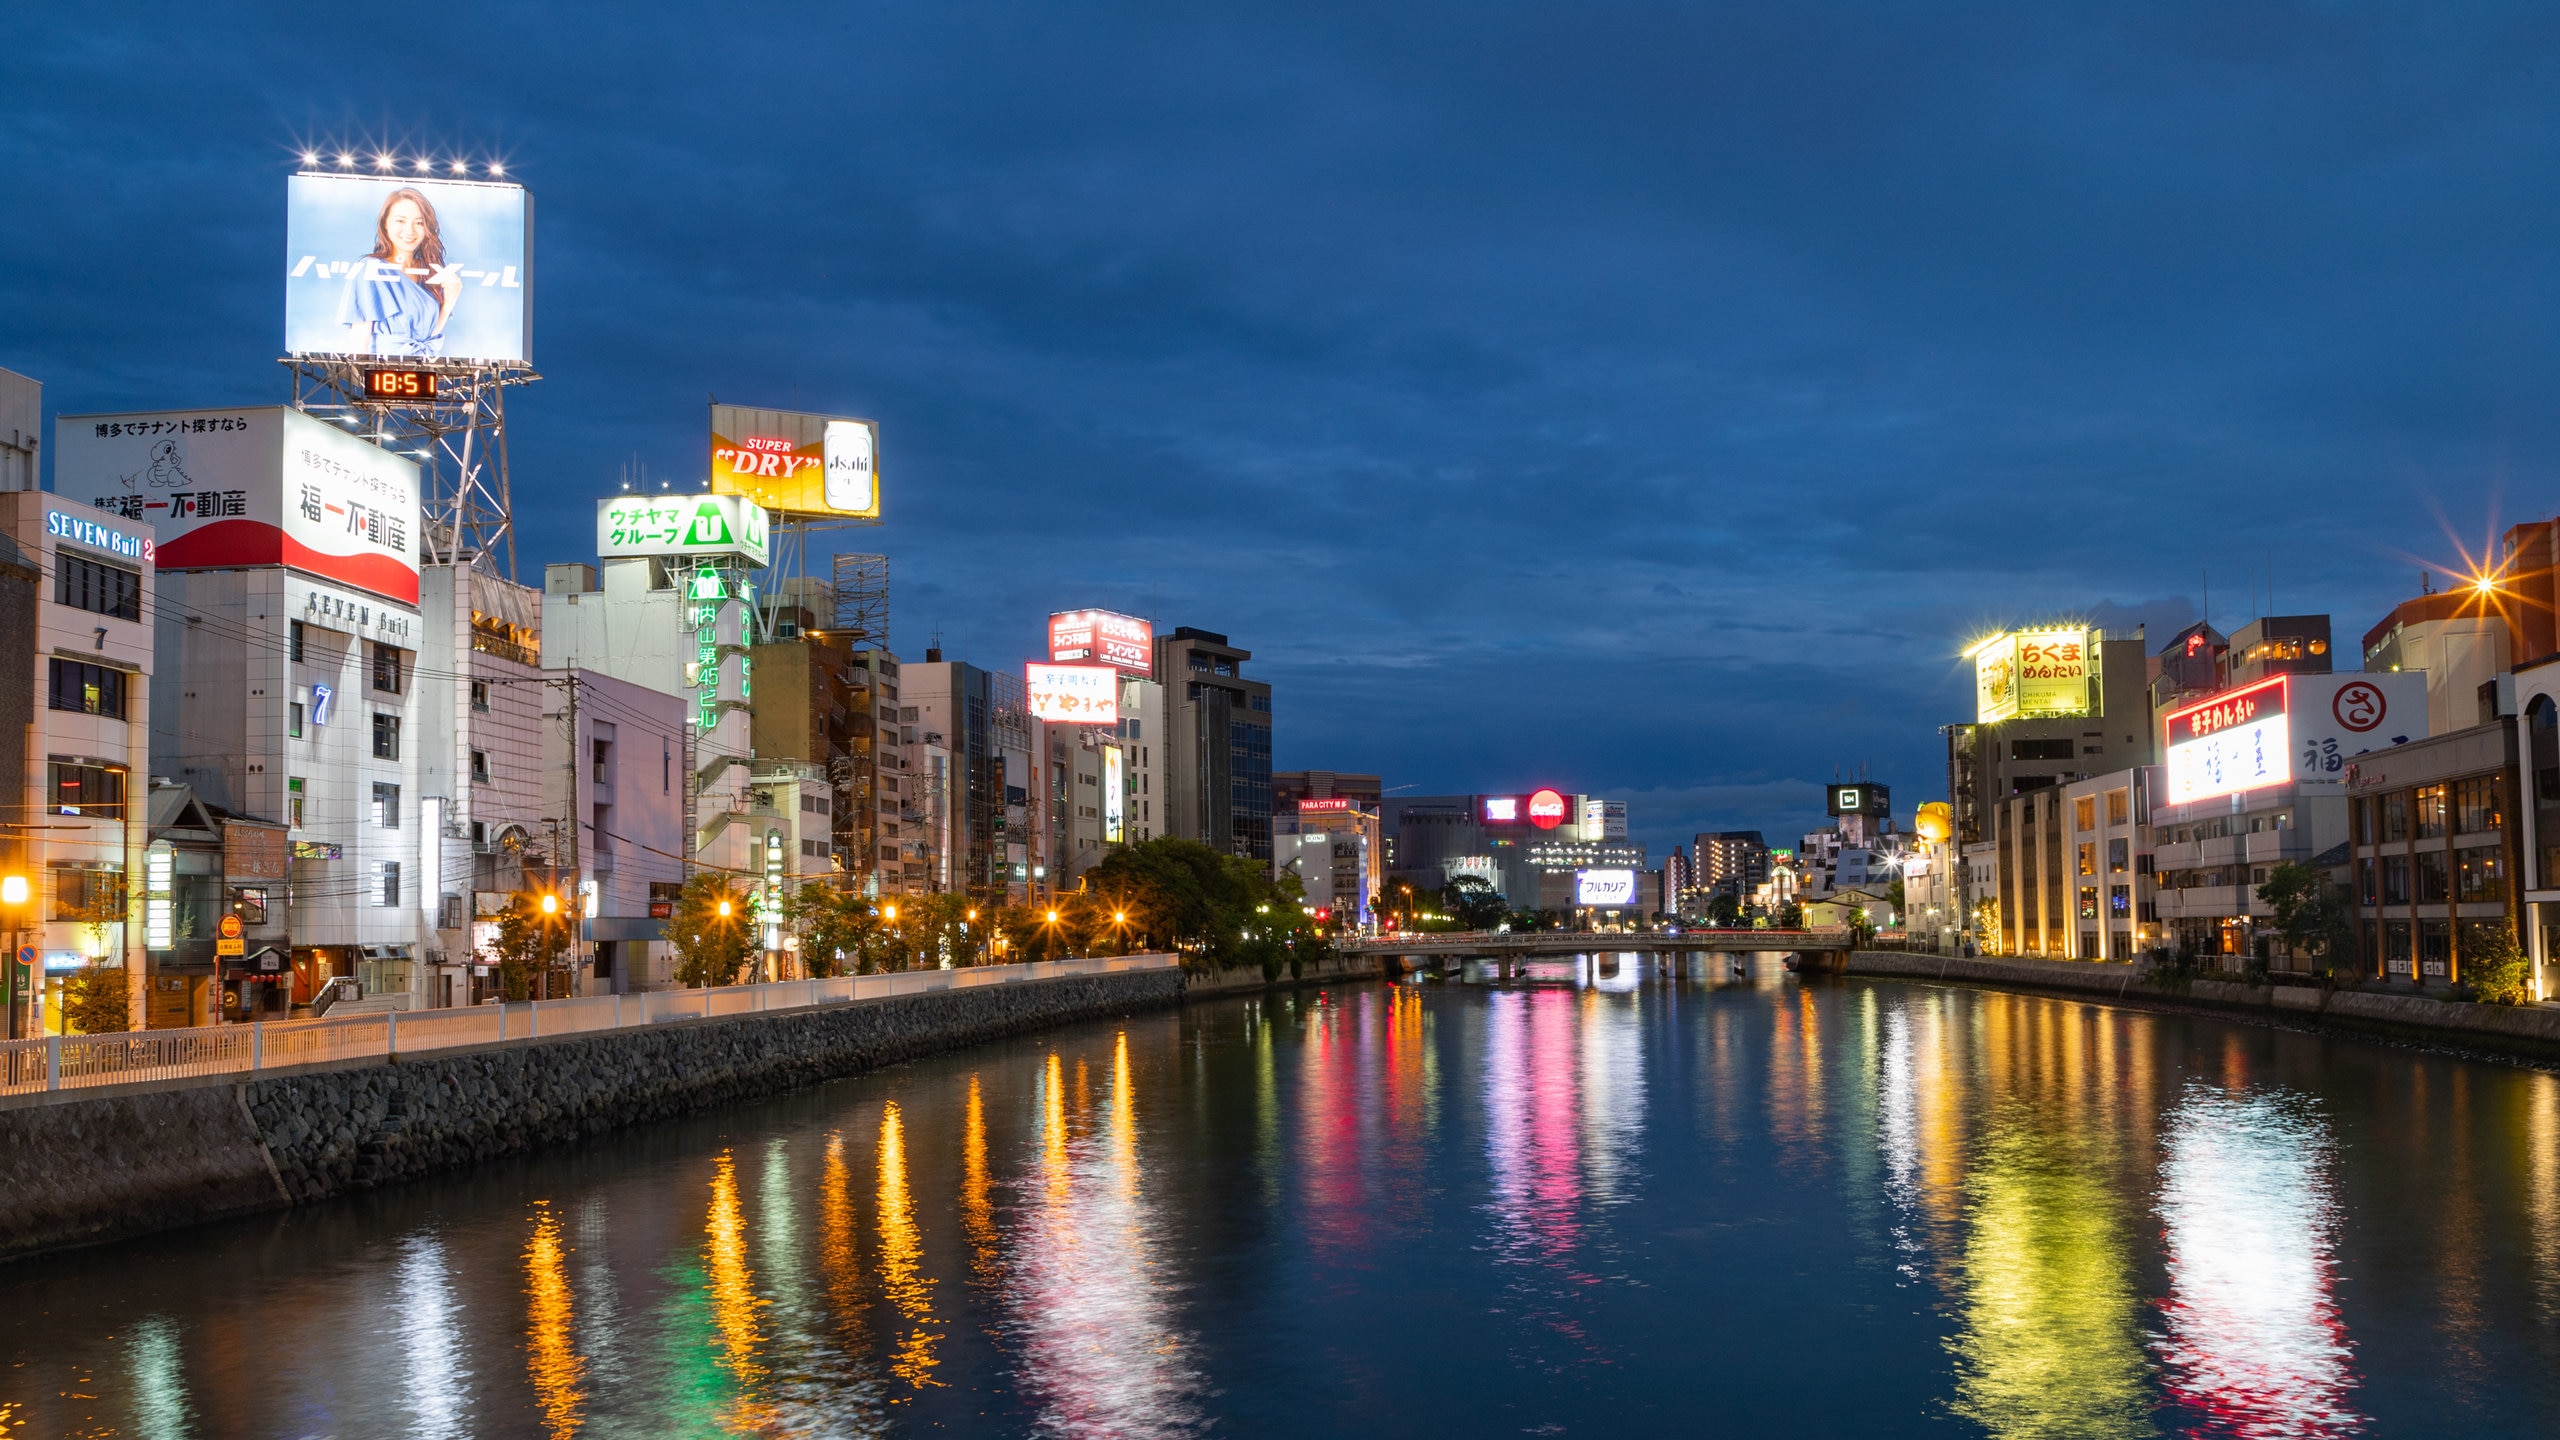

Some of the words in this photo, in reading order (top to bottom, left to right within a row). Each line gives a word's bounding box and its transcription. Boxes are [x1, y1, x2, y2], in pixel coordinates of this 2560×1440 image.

[290, 254, 520, 288] ハッピーメール
[374, 373, 436, 393] 18:51
[95, 417, 247, 438] 博多でテナント探すなら
[747, 438, 792, 452] SUPER
[829, 454, 868, 472] Asahi
[610, 508, 680, 527] ウチヤマ
[47, 511, 107, 548] SEVEN
[143, 537, 155, 562] 2
[610, 527, 681, 546] グループ
[310, 591, 369, 626] SEVEN
[94, 627, 108, 650] 7
[2021, 643, 2081, 663] ちくま
[698, 604, 719, 728] 内山第45ビル
[2022, 664, 2082, 679] めんたい
[313, 682, 332, 726] 7
[2191, 699, 2255, 737] 辛子めんたい
[1586, 881, 1627, 893] フルカリア
